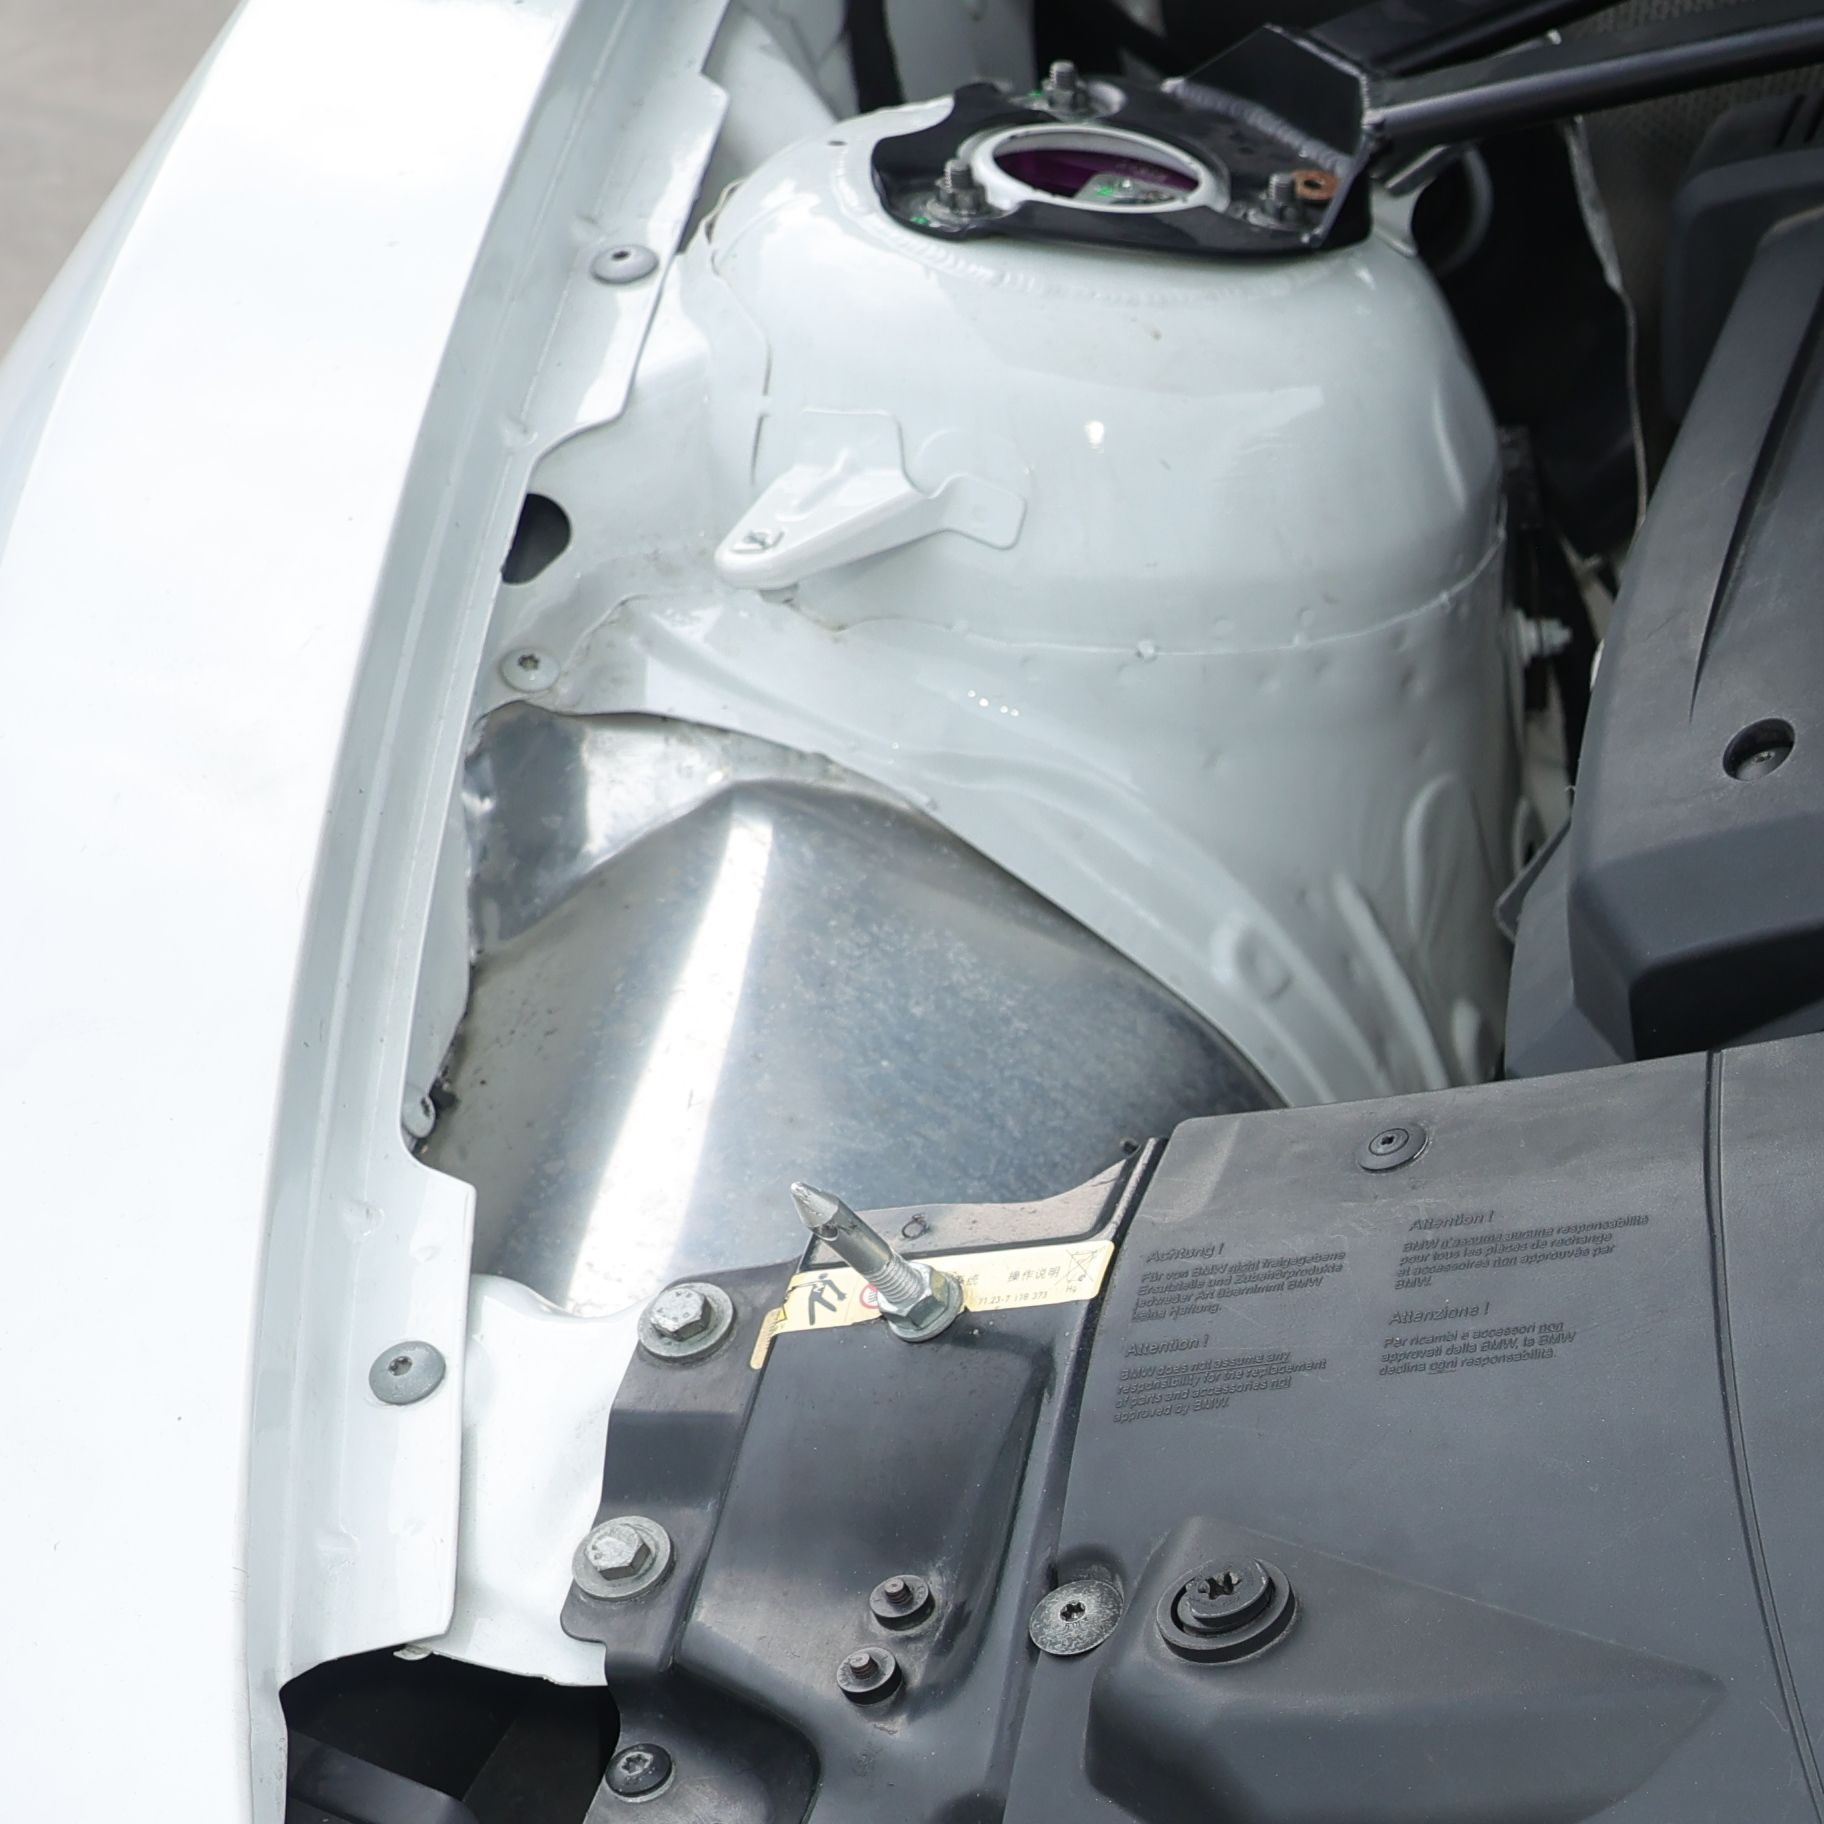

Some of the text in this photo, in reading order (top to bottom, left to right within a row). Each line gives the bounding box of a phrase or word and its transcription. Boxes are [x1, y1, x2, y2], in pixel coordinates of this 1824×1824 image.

[1409, 1213, 1483, 1231] Attention
[1403, 1239, 1440, 1252] BMW
[1147, 1246, 1214, 1263] Achtung
[1191, 1263, 1228, 1279] BMW
[1287, 1277, 1324, 1291] BMW
[1388, 1305, 1480, 1325] Attenzione
[1125, 1337, 1200, 1357] Attention
[1538, 1331, 1577, 1346] BMW
[1120, 1367, 1156, 1381] BMW
[1202, 1371, 1222, 1384] for
[1223, 1368, 1243, 1381] the
[1245, 1358, 1327, 1379] replacement
[1164, 1388, 1189, 1402] and
[1190, 1380, 1268, 1398] accessories
